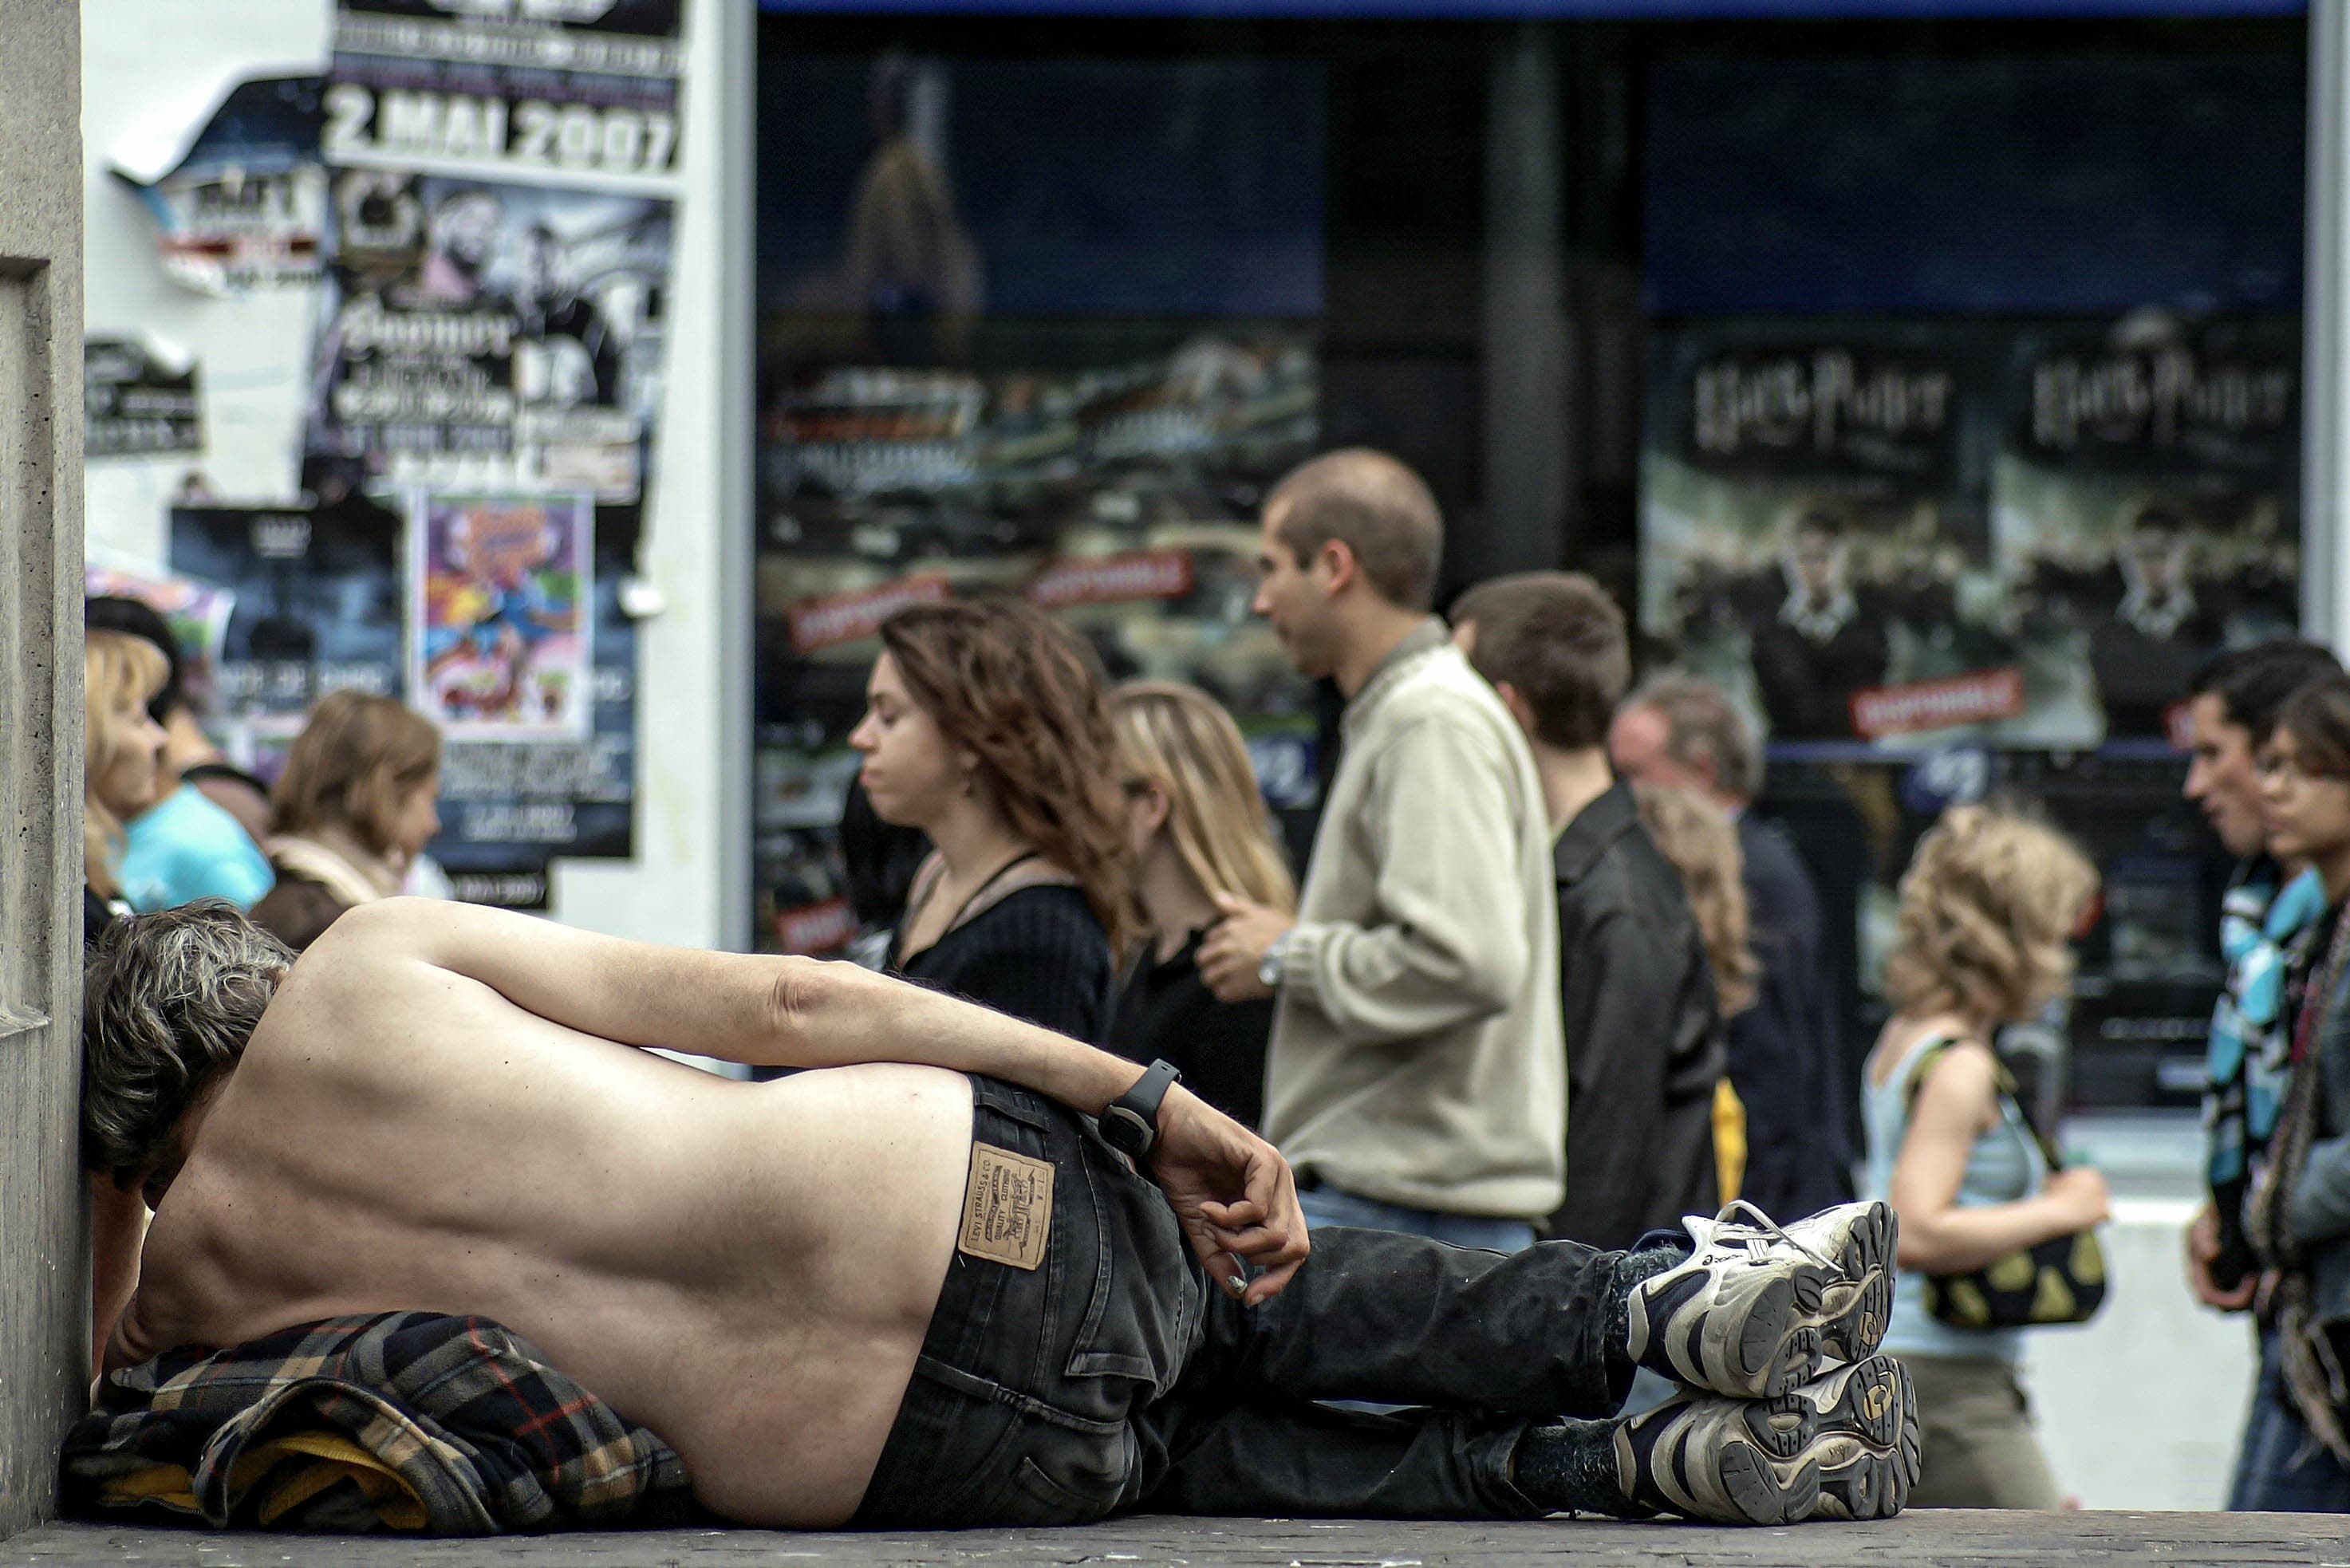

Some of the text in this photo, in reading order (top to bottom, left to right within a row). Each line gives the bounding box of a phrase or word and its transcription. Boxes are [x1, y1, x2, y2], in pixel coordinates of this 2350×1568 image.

[322, 82, 678, 175] 2 MAI 2007
[975, 1180, 988, 1219] STRAUSS
[995, 1168, 1011, 1240] QUALITY CLOTHING
[971, 1221, 983, 1242] LEVI
